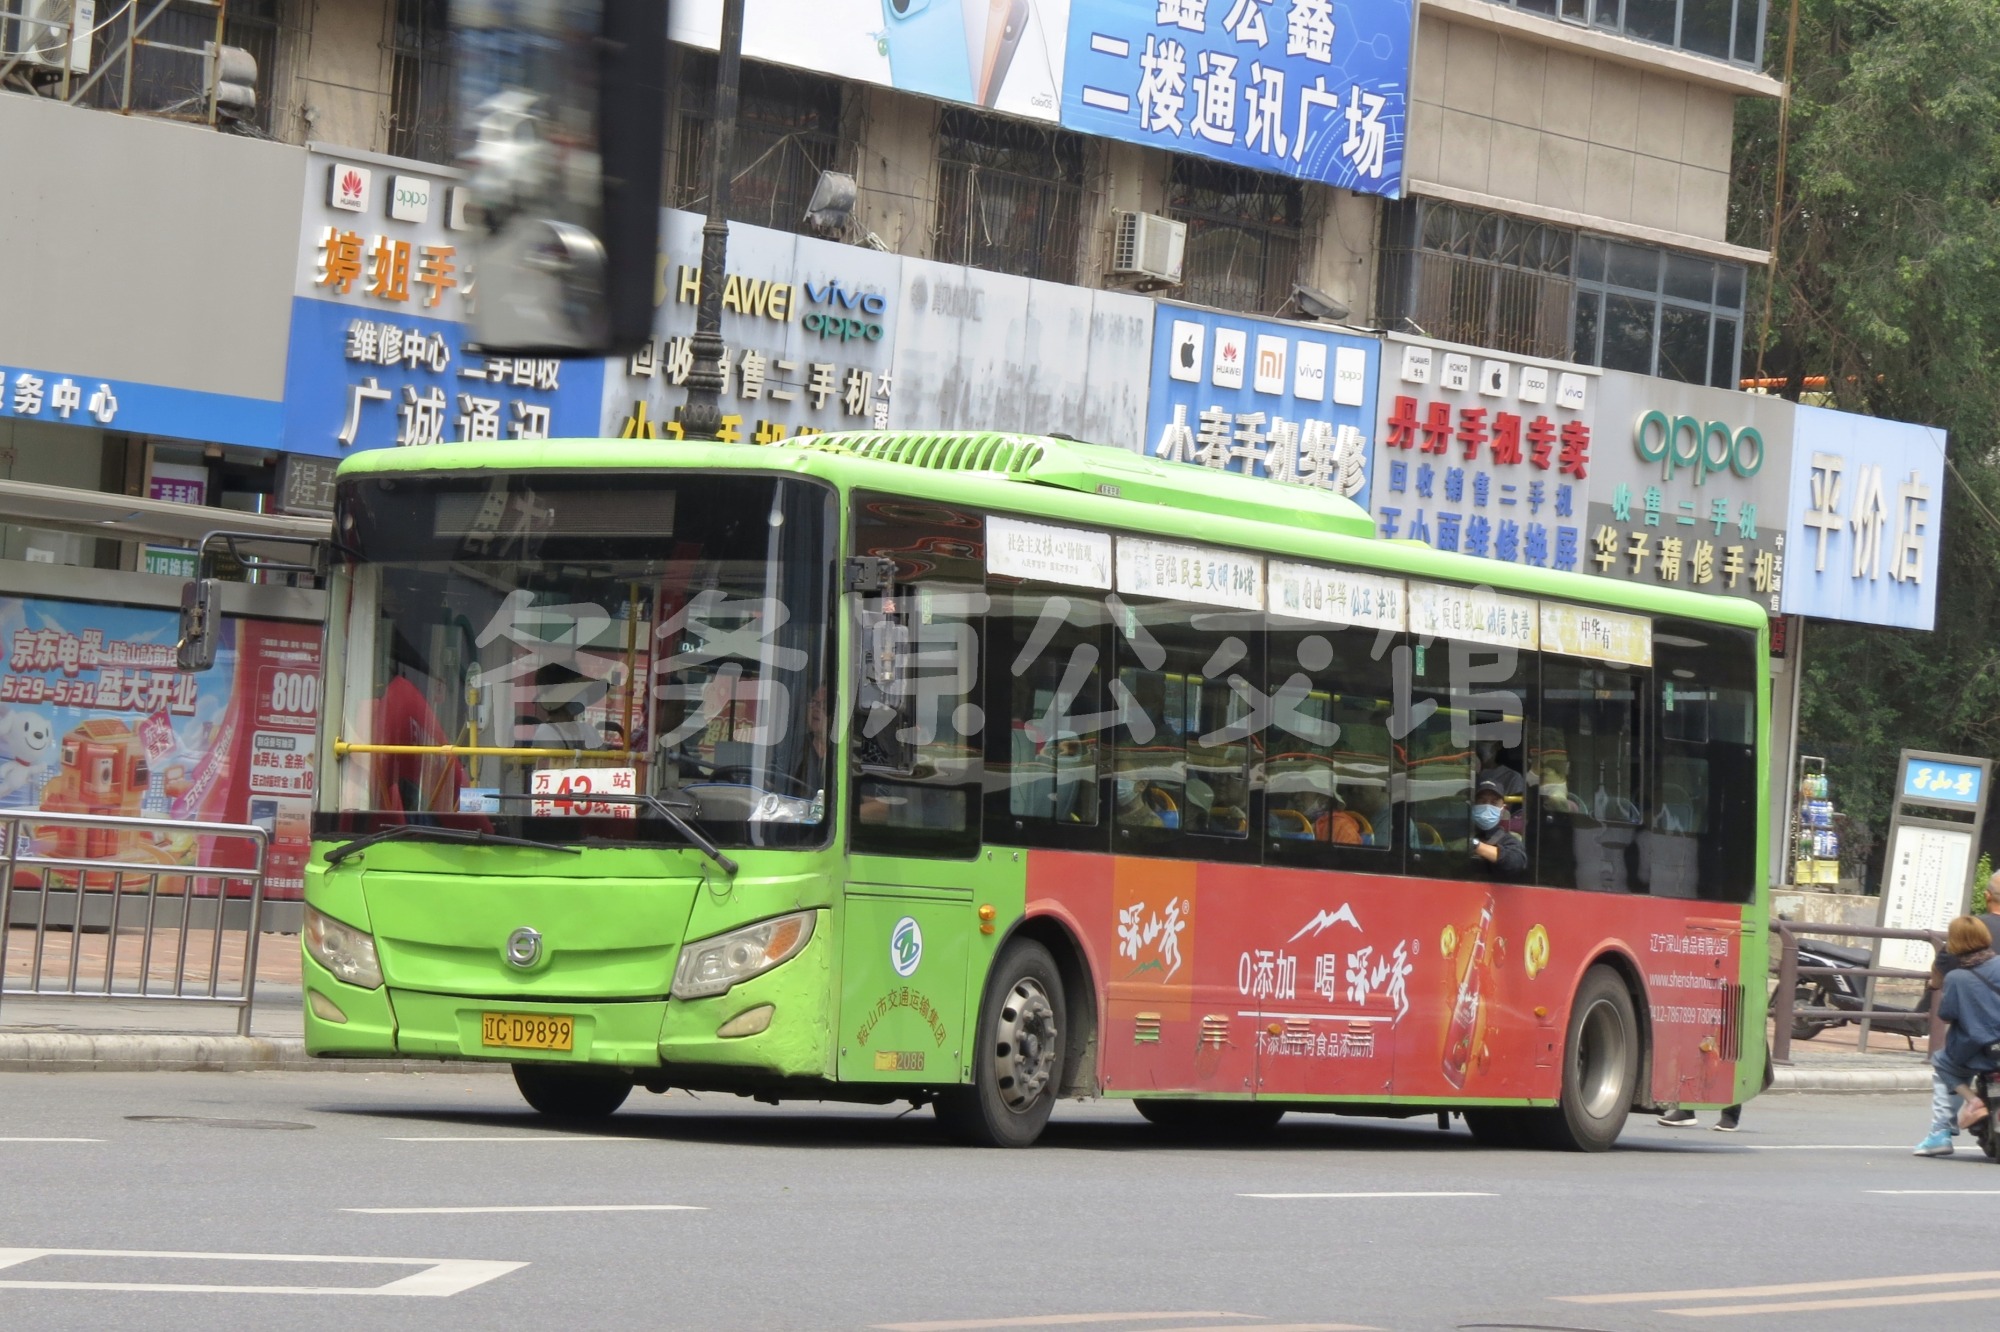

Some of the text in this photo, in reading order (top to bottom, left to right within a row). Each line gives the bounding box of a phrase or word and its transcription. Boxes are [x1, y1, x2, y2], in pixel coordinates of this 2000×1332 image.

[1082, 34, 1387, 179] 二楼通讯广场
[316, 226, 477, 307] 婷姐手
[679, 265, 797, 322] HAWEI
[347, 320, 451, 373] 维修中心
[1216, 364, 1242, 377] HUAWEI
[1449, 362, 1468, 374] HONOR
[0, 371, 118, 423] 务中心
[338, 377, 550, 447] 广诚通讯
[1155, 403, 1367, 498] 小春手机维修
[1386, 395, 1591, 480] 丹丹手机专卖
[1389, 459, 1574, 517] 回收销售二手机
[1612, 482, 1758, 540] 收售二手机
[1802, 450, 1932, 585] 平价店
[1007, 532, 1093, 563] 社会主义核心价值观
[1590, 524, 1775, 595] 华子精修手机
[10, 629, 103, 675] 京东电器
[1, 667, 197, 713] 5/29-5/31 盛大开业
[271, 671, 321, 714] 800
[1650, 932, 1729, 957] 辽宁深山食品有限公司
[1238, 949, 1297, 1000] 0添加
[1313, 953, 1335, 1003] 喝
[856, 986, 947, 1049] 鞍山市交通运输集团
